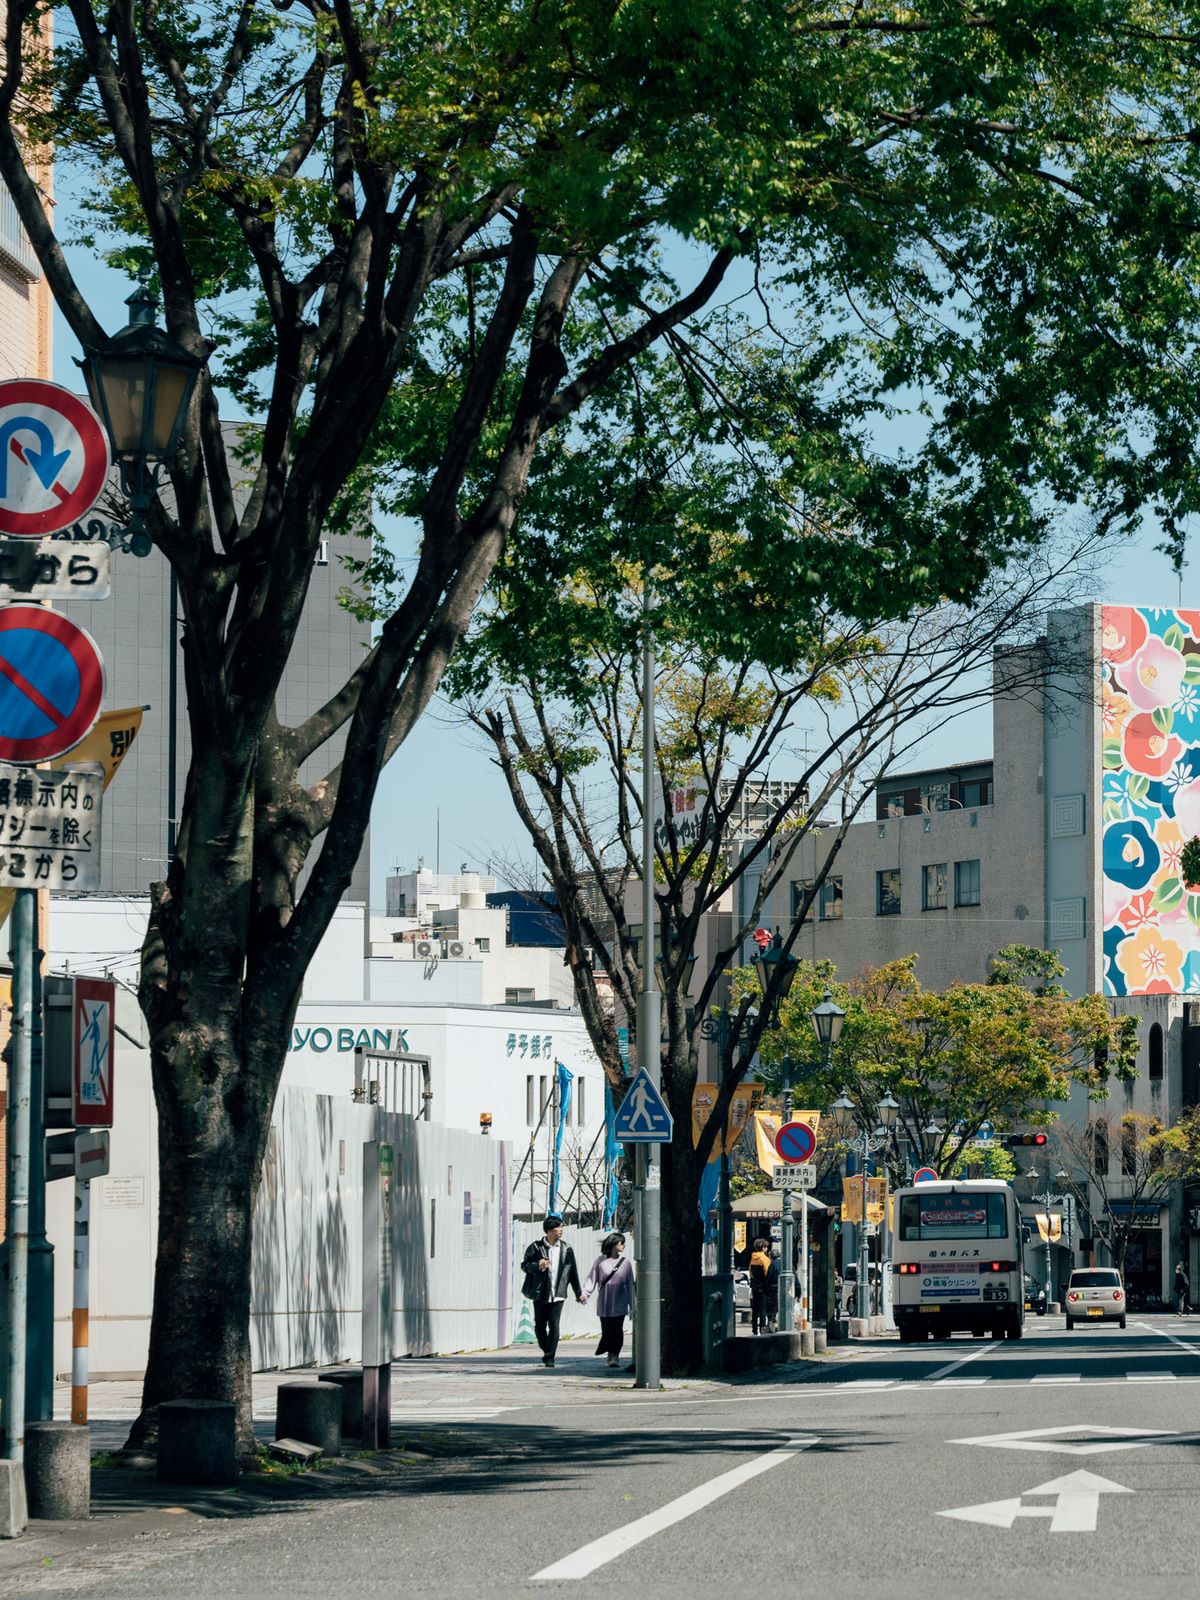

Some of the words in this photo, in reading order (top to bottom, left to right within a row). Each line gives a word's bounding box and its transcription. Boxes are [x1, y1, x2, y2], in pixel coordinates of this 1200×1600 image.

[0, 815, 92, 848] シーを除く
[337, 1028, 410, 1053] BANK
[506, 1032, 553, 1060] 伊予銀行
[928, 1249, 981, 1258] 亀の井バス
